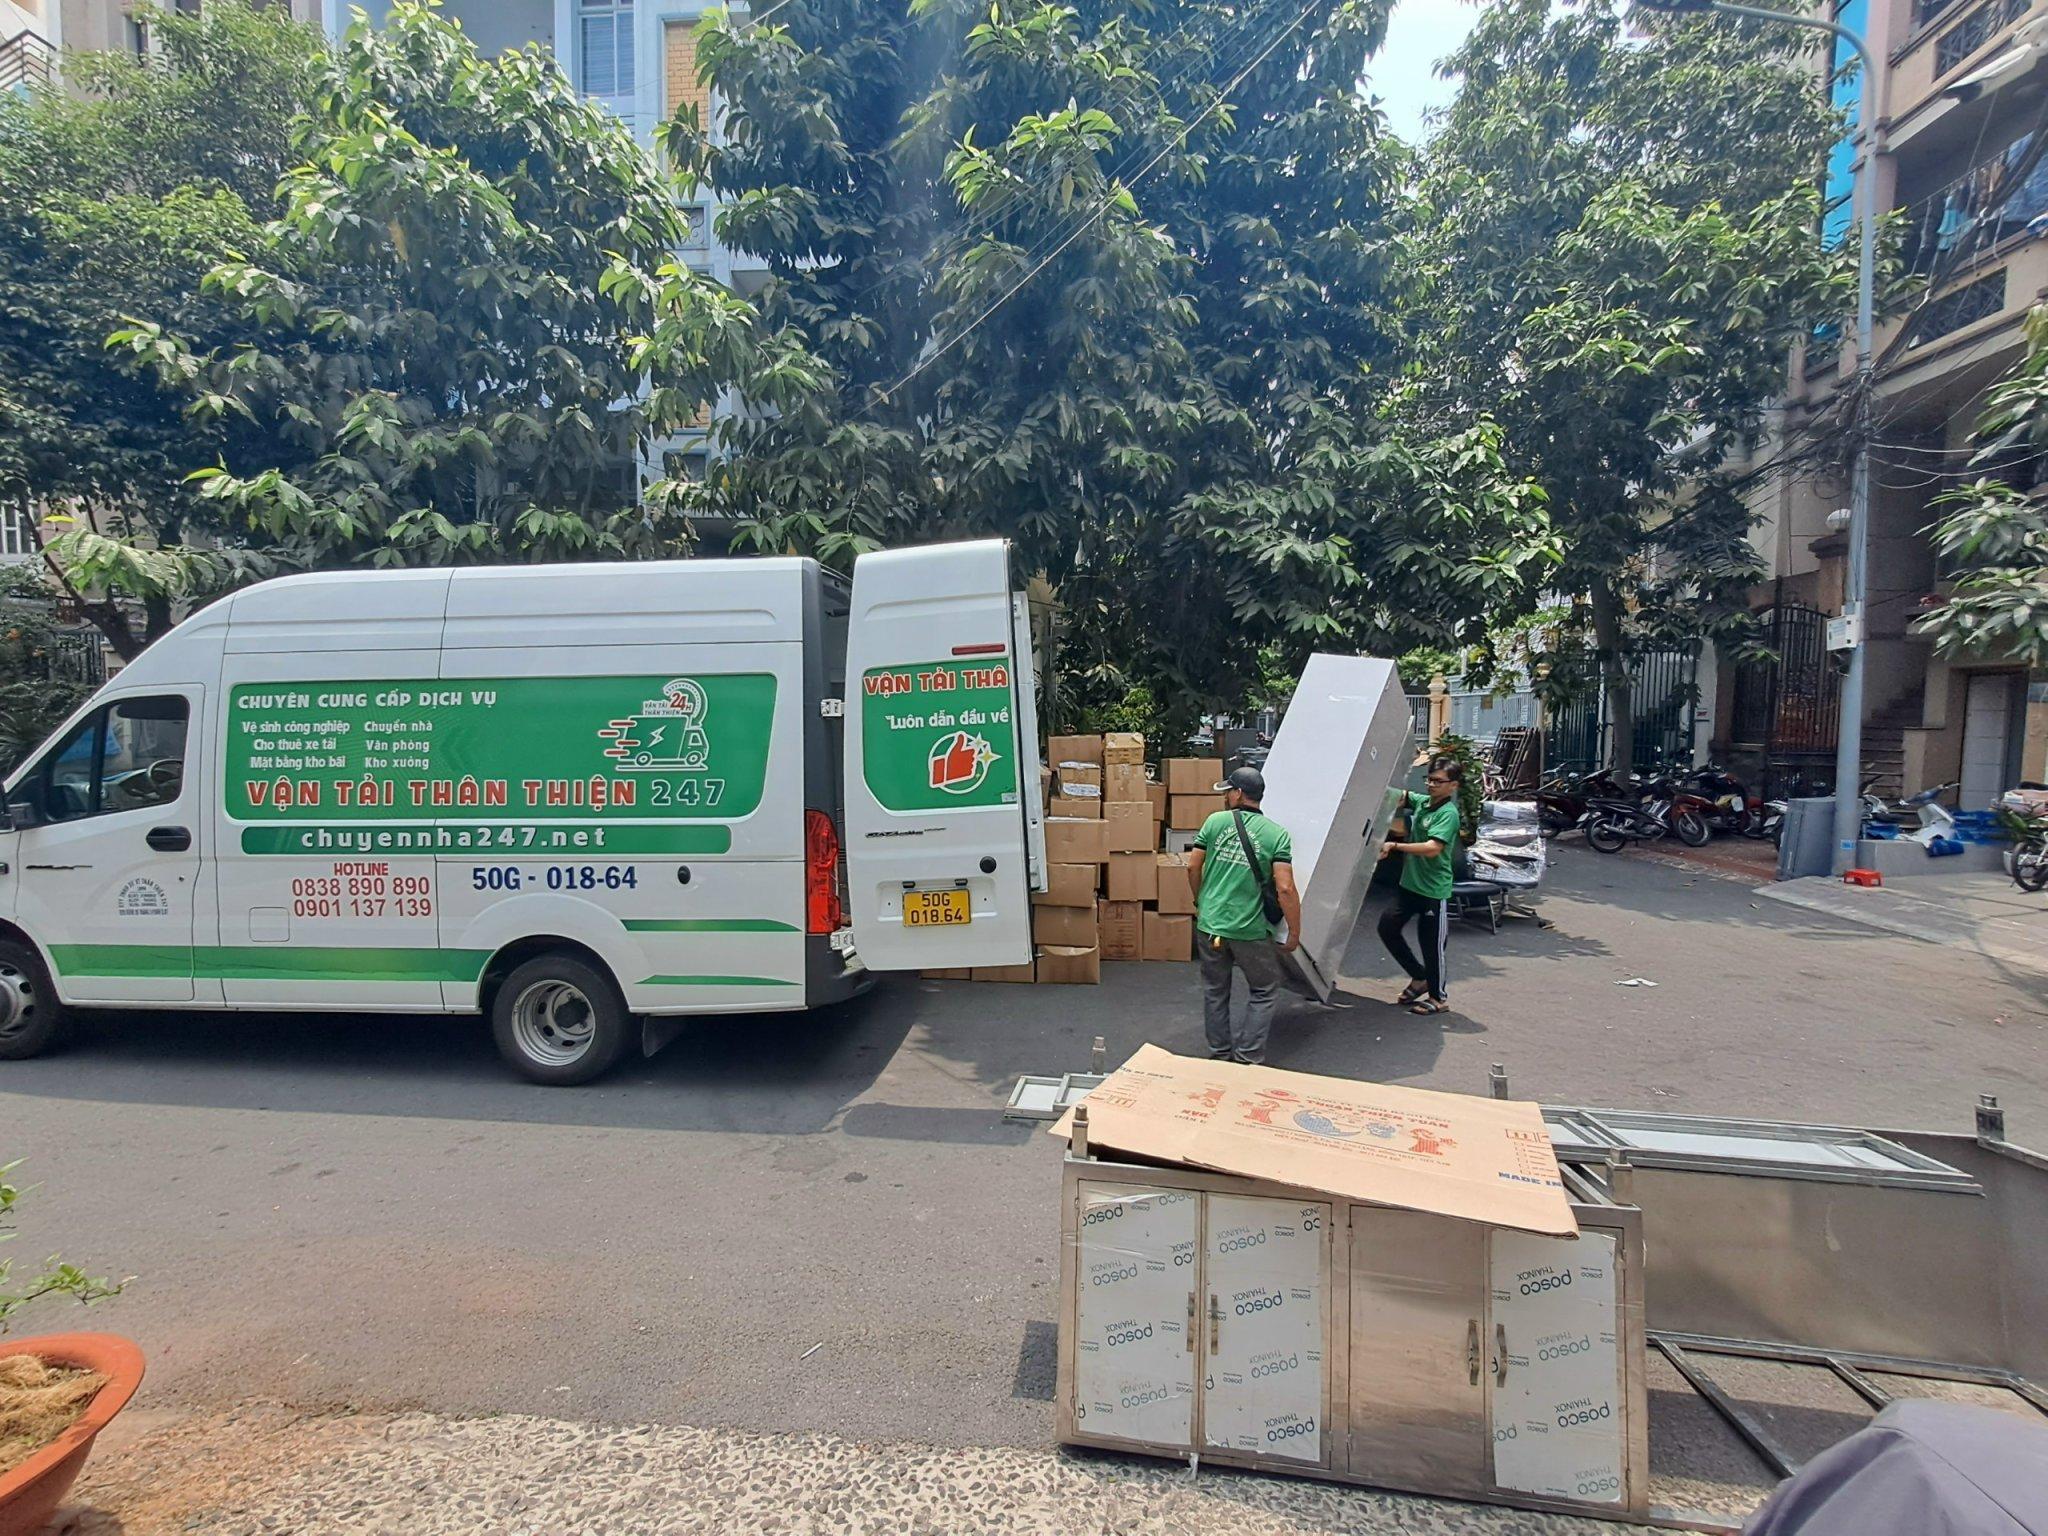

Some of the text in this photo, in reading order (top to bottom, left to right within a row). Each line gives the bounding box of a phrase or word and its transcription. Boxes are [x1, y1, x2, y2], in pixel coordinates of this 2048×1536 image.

[864, 671, 912, 699] VẬN
[917, 666, 957, 692] TẢI
[238, 688, 497, 709] CHUYÊN CUNG CẤP DỊCH VỤ
[411, 720, 433, 732] nhà
[928, 709, 955, 727] dẫn
[959, 707, 986, 726] đầu
[990, 706, 1010, 723] về
[242, 720, 350, 735] Vệ sinh công nghiệp
[253, 737, 337, 750] Cho thuê xe tải
[392, 739, 429, 753] phòng
[305, 756, 326, 768] kho
[328, 755, 346, 768] bãi
[365, 757, 388, 768] Kho
[246, 772, 725, 812] VẬN TẢI THÂN THIỆN 247
[301, 827, 607, 852] chuyennha247.net
[333, 862, 389, 877] HOTLINE
[472, 867, 521, 891] 50G
[546, 866, 638, 890] 018-64
[292, 877, 430, 897] 0838 890 890
[294, 899, 432, 918] 0901 137 139
[921, 893, 951, 907] 50G
[911, 908, 963, 924] 018.64
[1220, 1228, 1266, 1253] posco
[1093, 1263, 1138, 1286] posco
[1516, 1266, 1555, 1281] THAINOX
[1520, 1269, 1572, 1296] posco
[1232, 1287, 1267, 1302] THAINOX
[1235, 1290, 1283, 1316] posco
[1104, 1319, 1138, 1334] THAINOX
[1108, 1323, 1153, 1346] posco
[1539, 1335, 1590, 1361] posco
[1251, 1353, 1298, 1378] posco
[1122, 1385, 1168, 1408] posco
[1554, 1397, 1592, 1413] THAINOX
[1264, 1413, 1299, 1428] THAINOX
[1558, 1401, 1610, 1428] posco
[1267, 1416, 1315, 1442] posco
